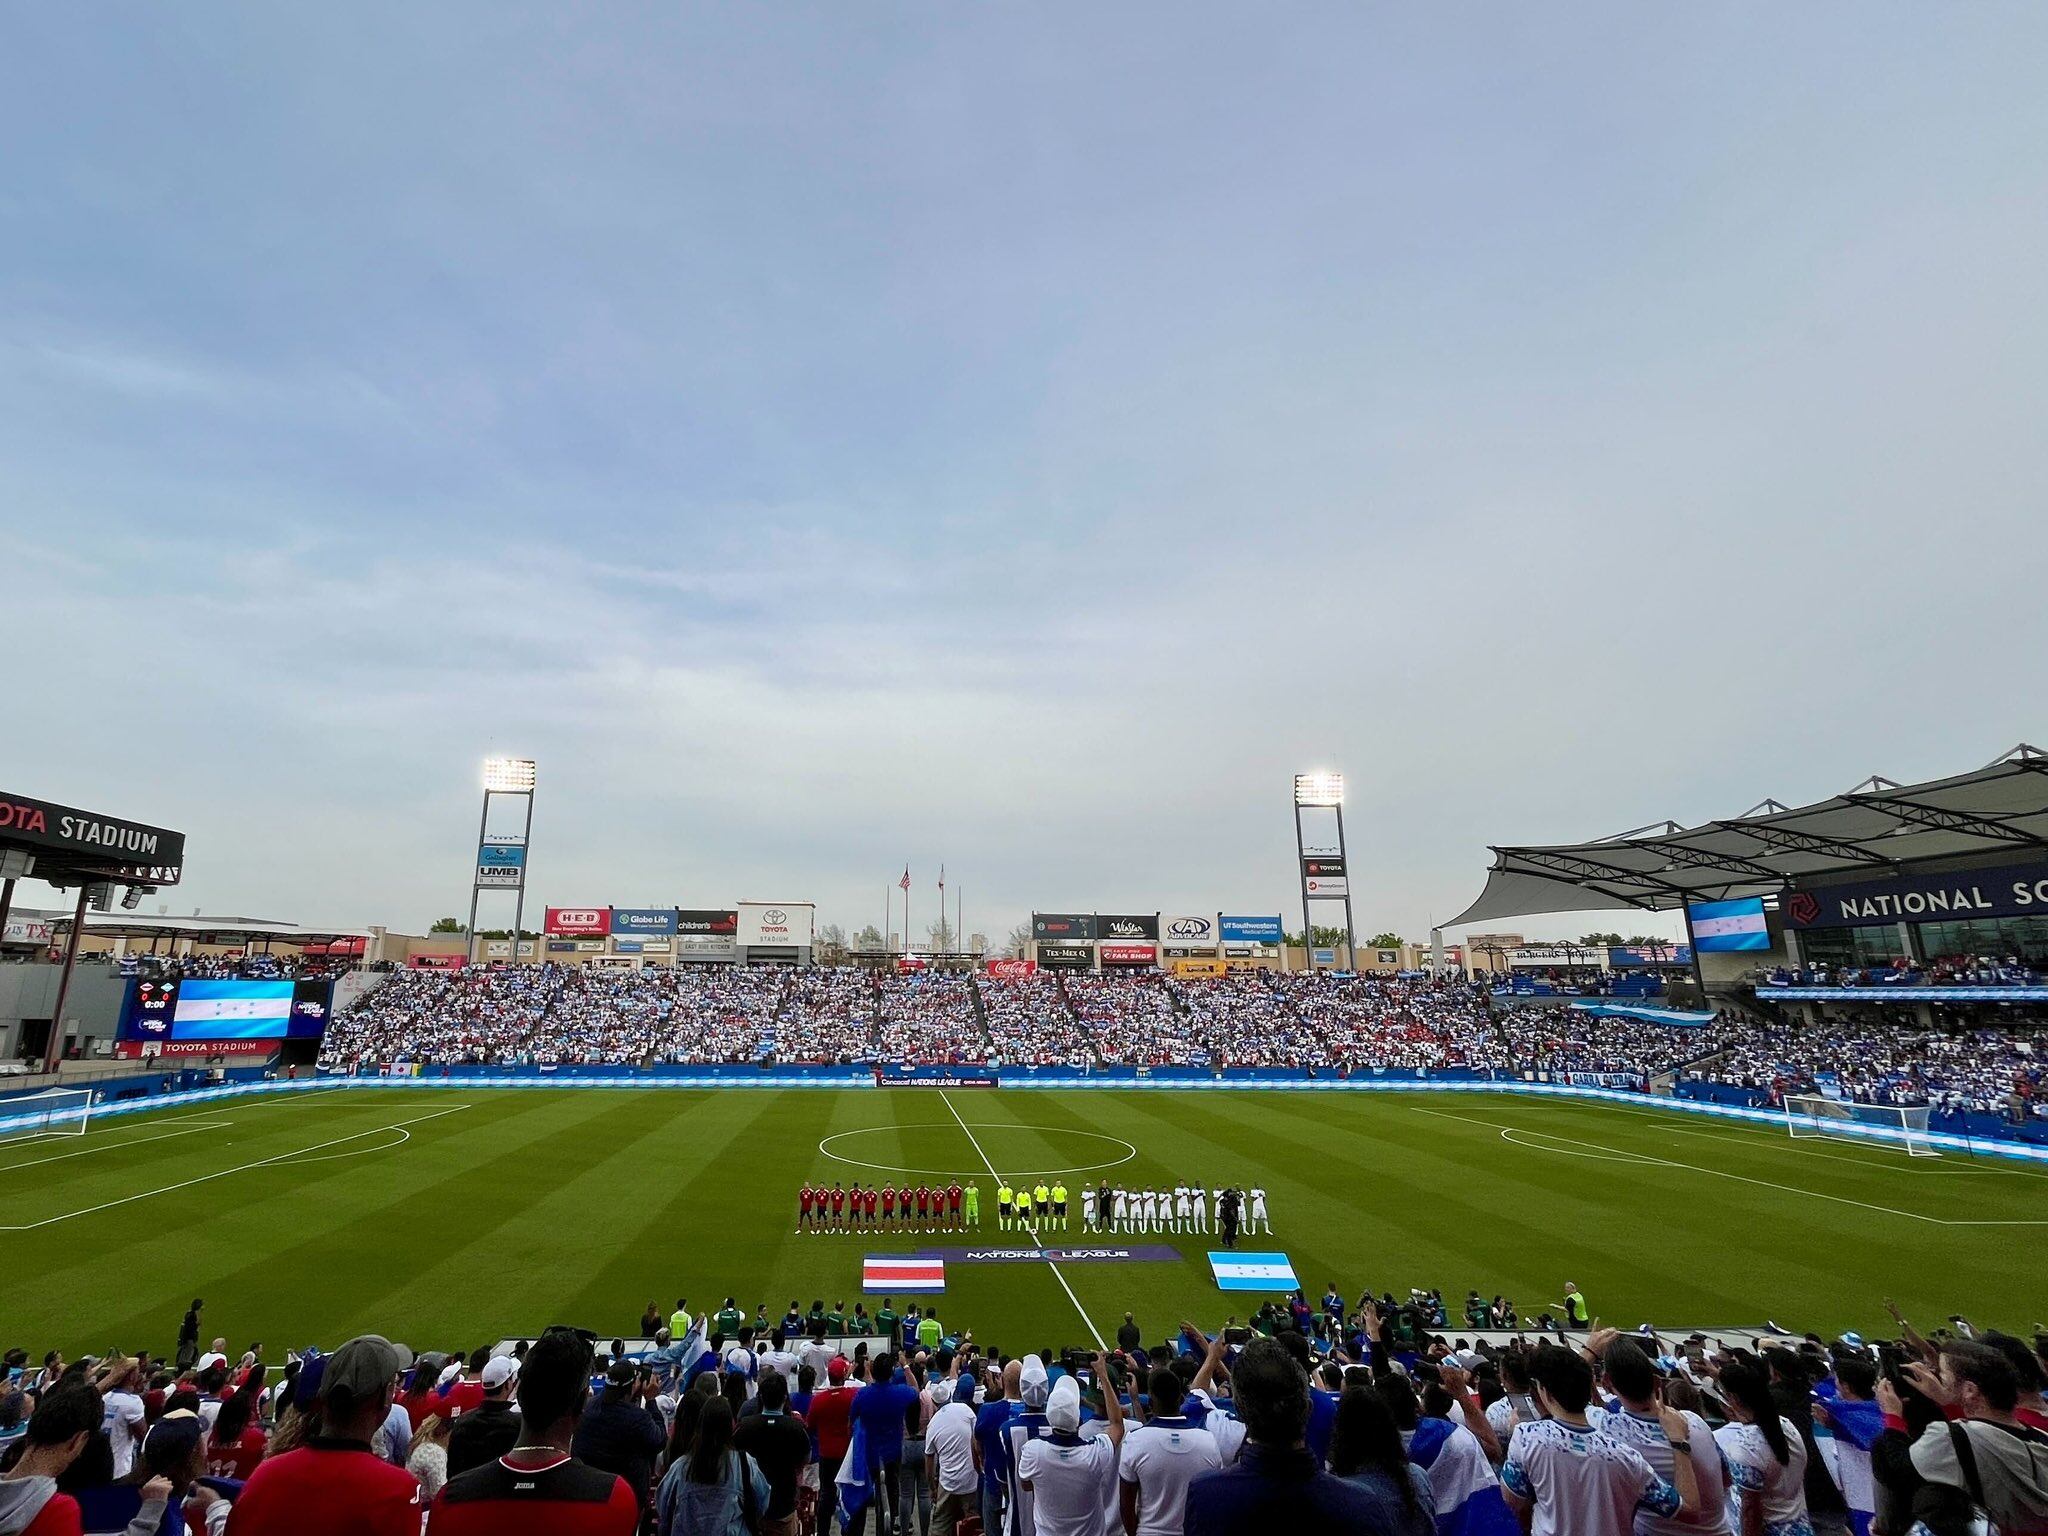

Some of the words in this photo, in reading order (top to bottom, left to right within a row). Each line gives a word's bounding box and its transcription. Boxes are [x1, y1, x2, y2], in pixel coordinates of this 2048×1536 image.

[59, 816, 158, 855] STADIUM
[480, 867, 519, 876] UMB
[1840, 887, 1992, 919] NATIONAL
[630, 915, 653, 924] Globe
[654, 915, 669, 924] Life
[26, 923, 49, 939] TX
[144, 1000, 165, 1009] 0:00
[165, 1043, 207, 1052] TOYOTA
[212, 1041, 256, 1051] STADIUM
[911, 1078, 937, 1086] NATIONS
[937, 1078, 962, 1086] LEAGUE
